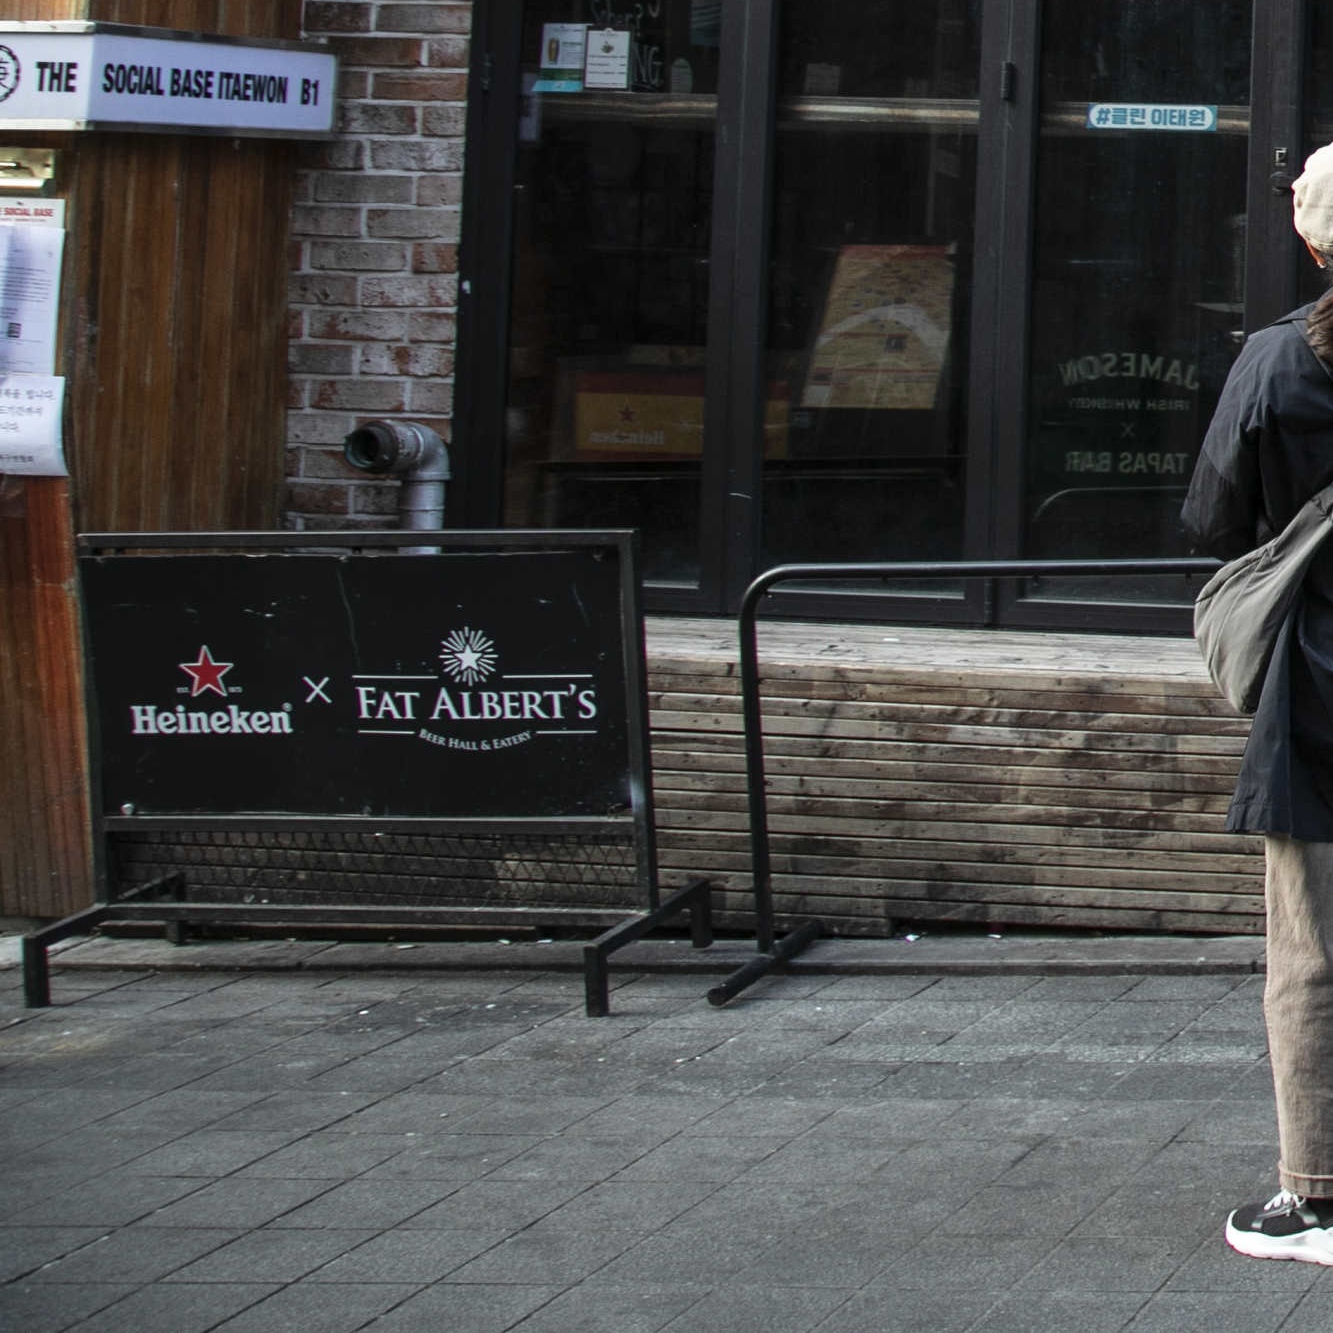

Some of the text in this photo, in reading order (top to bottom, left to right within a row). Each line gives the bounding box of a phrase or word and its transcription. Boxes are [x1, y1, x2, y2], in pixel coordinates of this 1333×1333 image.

[37, 61, 320, 106] THE SOCIAL BASE ITAEWON B1
[1096, 107, 1207, 128] #클린 이태원
[354, 686, 421, 719] FAT
[430, 683, 598, 720] ALBERT'S
[131, 704, 293, 735] Heineken
[418, 728, 533, 751] BEER HALL & EATERY
